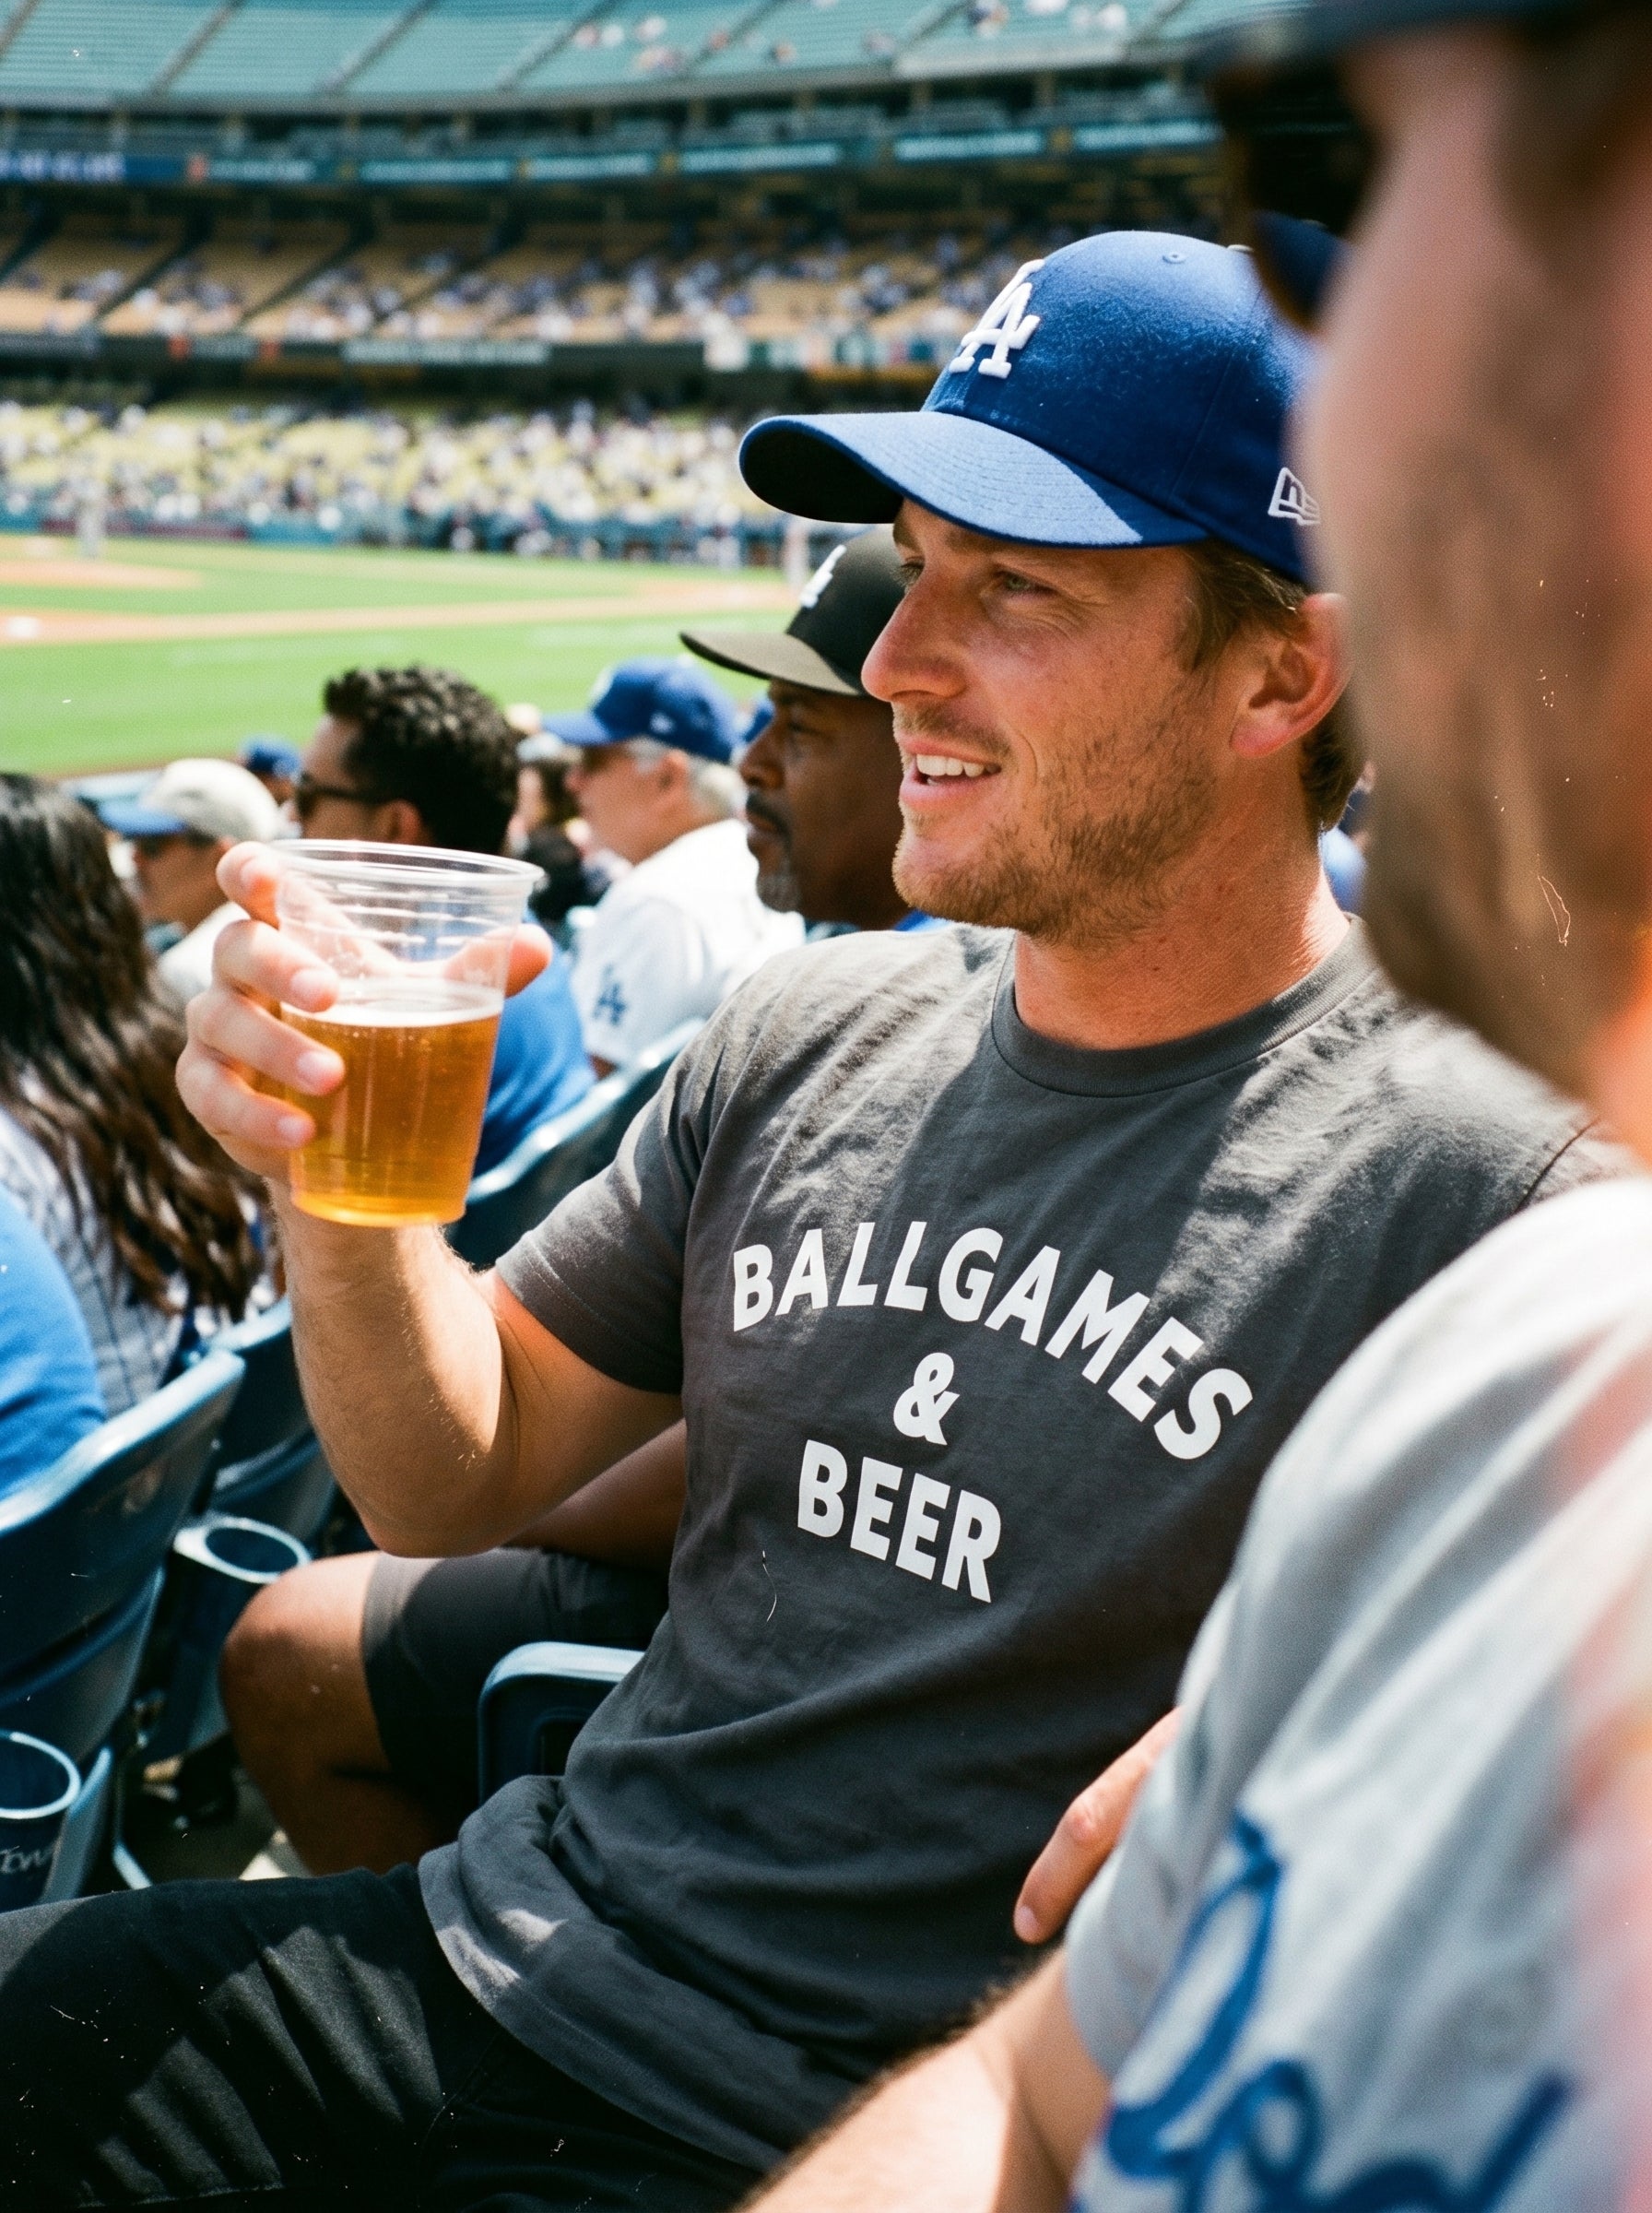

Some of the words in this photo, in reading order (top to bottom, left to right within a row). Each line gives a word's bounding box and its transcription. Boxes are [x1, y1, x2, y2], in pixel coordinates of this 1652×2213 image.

[950, 259, 1045, 379] LA
[734, 1221, 1253, 1460] BALLGAMES
[892, 1352, 960, 1445] &
[797, 1439, 1001, 1603] BEER
